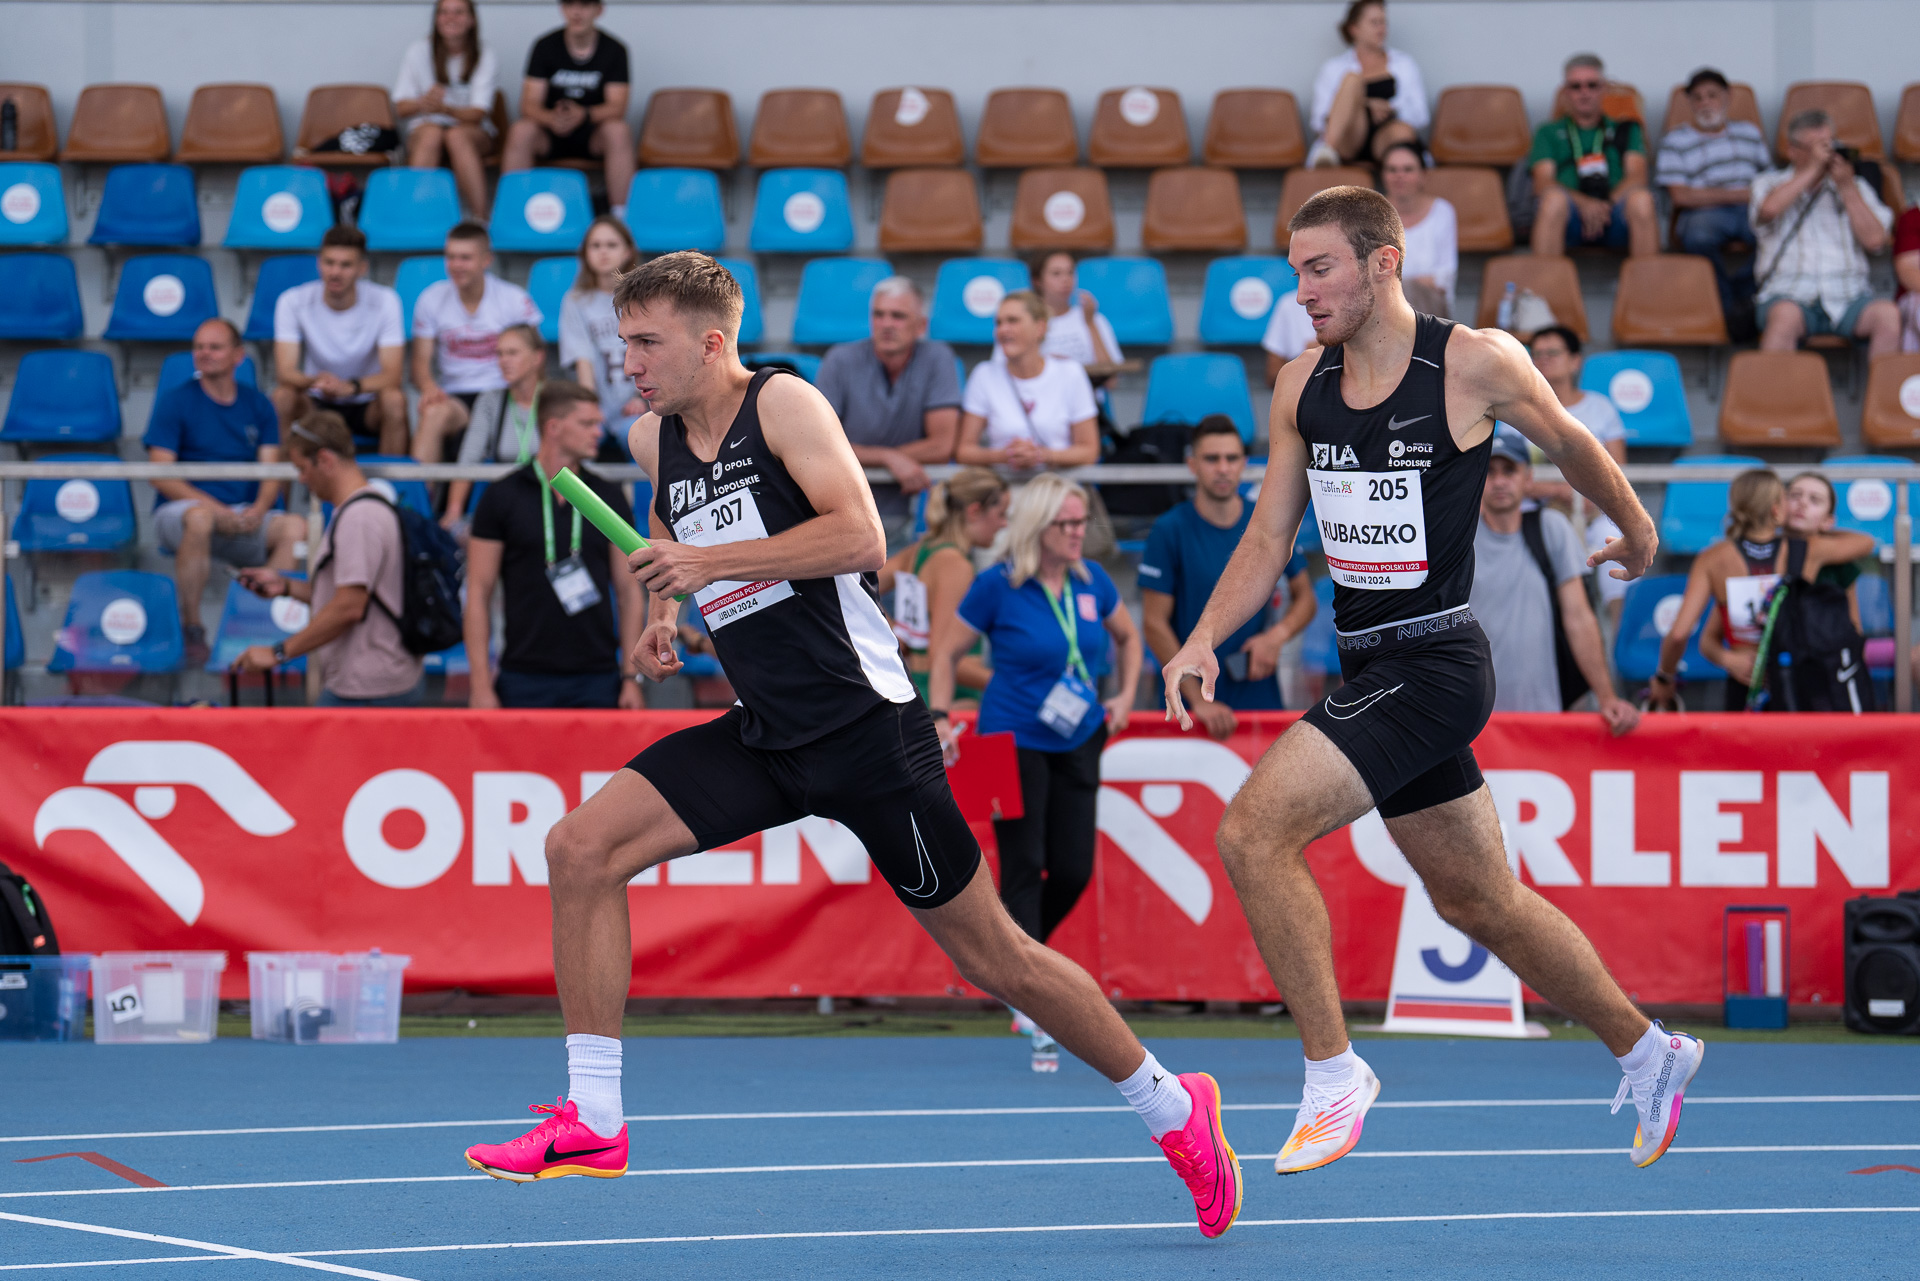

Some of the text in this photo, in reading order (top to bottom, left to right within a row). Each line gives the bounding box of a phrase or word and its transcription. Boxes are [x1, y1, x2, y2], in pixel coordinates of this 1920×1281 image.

[725, 457, 753, 471] OPOLE
[1393, 460, 1432, 468] OPOLSKIE
[718, 474, 760, 495] OPOLSKIE
[1368, 477, 1409, 501] 205
[711, 497, 742, 531] 207
[1321, 519, 1417, 545] KUBASZKO
[1340, 561, 1380, 571] MISTRZOSTWA
[1380, 563, 1405, 571] POLSKI
[1343, 573, 1391, 585] LUBLIN 2024
[714, 591, 744, 608] MISTRZOSTWA
[744, 581, 767, 596] POLSKI
[736, 598, 758, 613] 2024
[1397, 616, 1450, 641] NIKE
[1347, 633, 1381, 650] PRO
[342, 768, 872, 889] ORN
[112, 994, 136, 1012] 5
[1650, 1051, 1676, 1122] new balance
